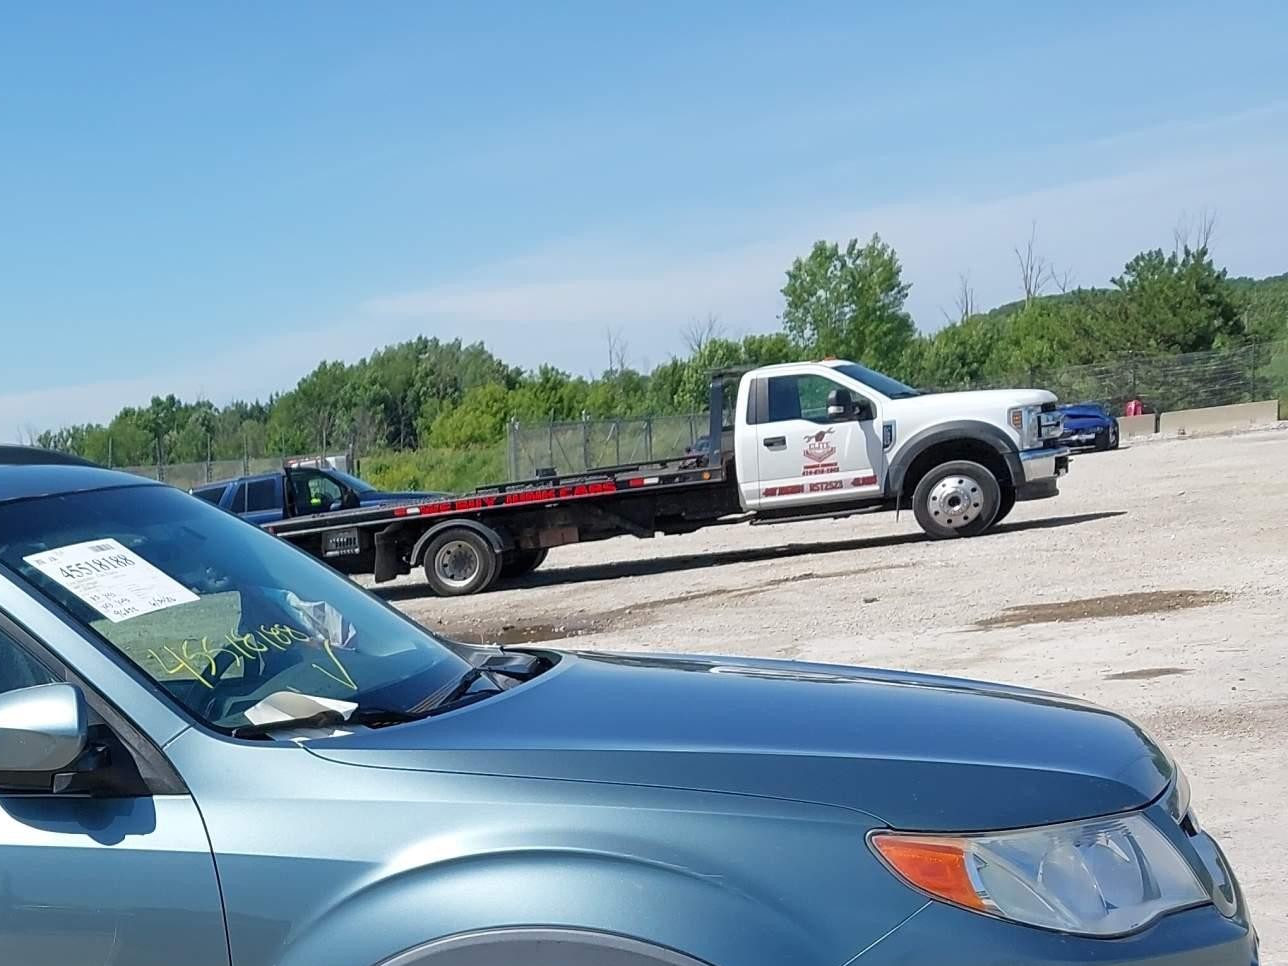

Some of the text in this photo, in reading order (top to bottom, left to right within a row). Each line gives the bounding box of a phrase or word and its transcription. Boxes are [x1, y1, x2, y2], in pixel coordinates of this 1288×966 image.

[456, 497, 496, 510] BUY
[559, 480, 616, 497] CARS
[58, 554, 135, 580] 45518188
